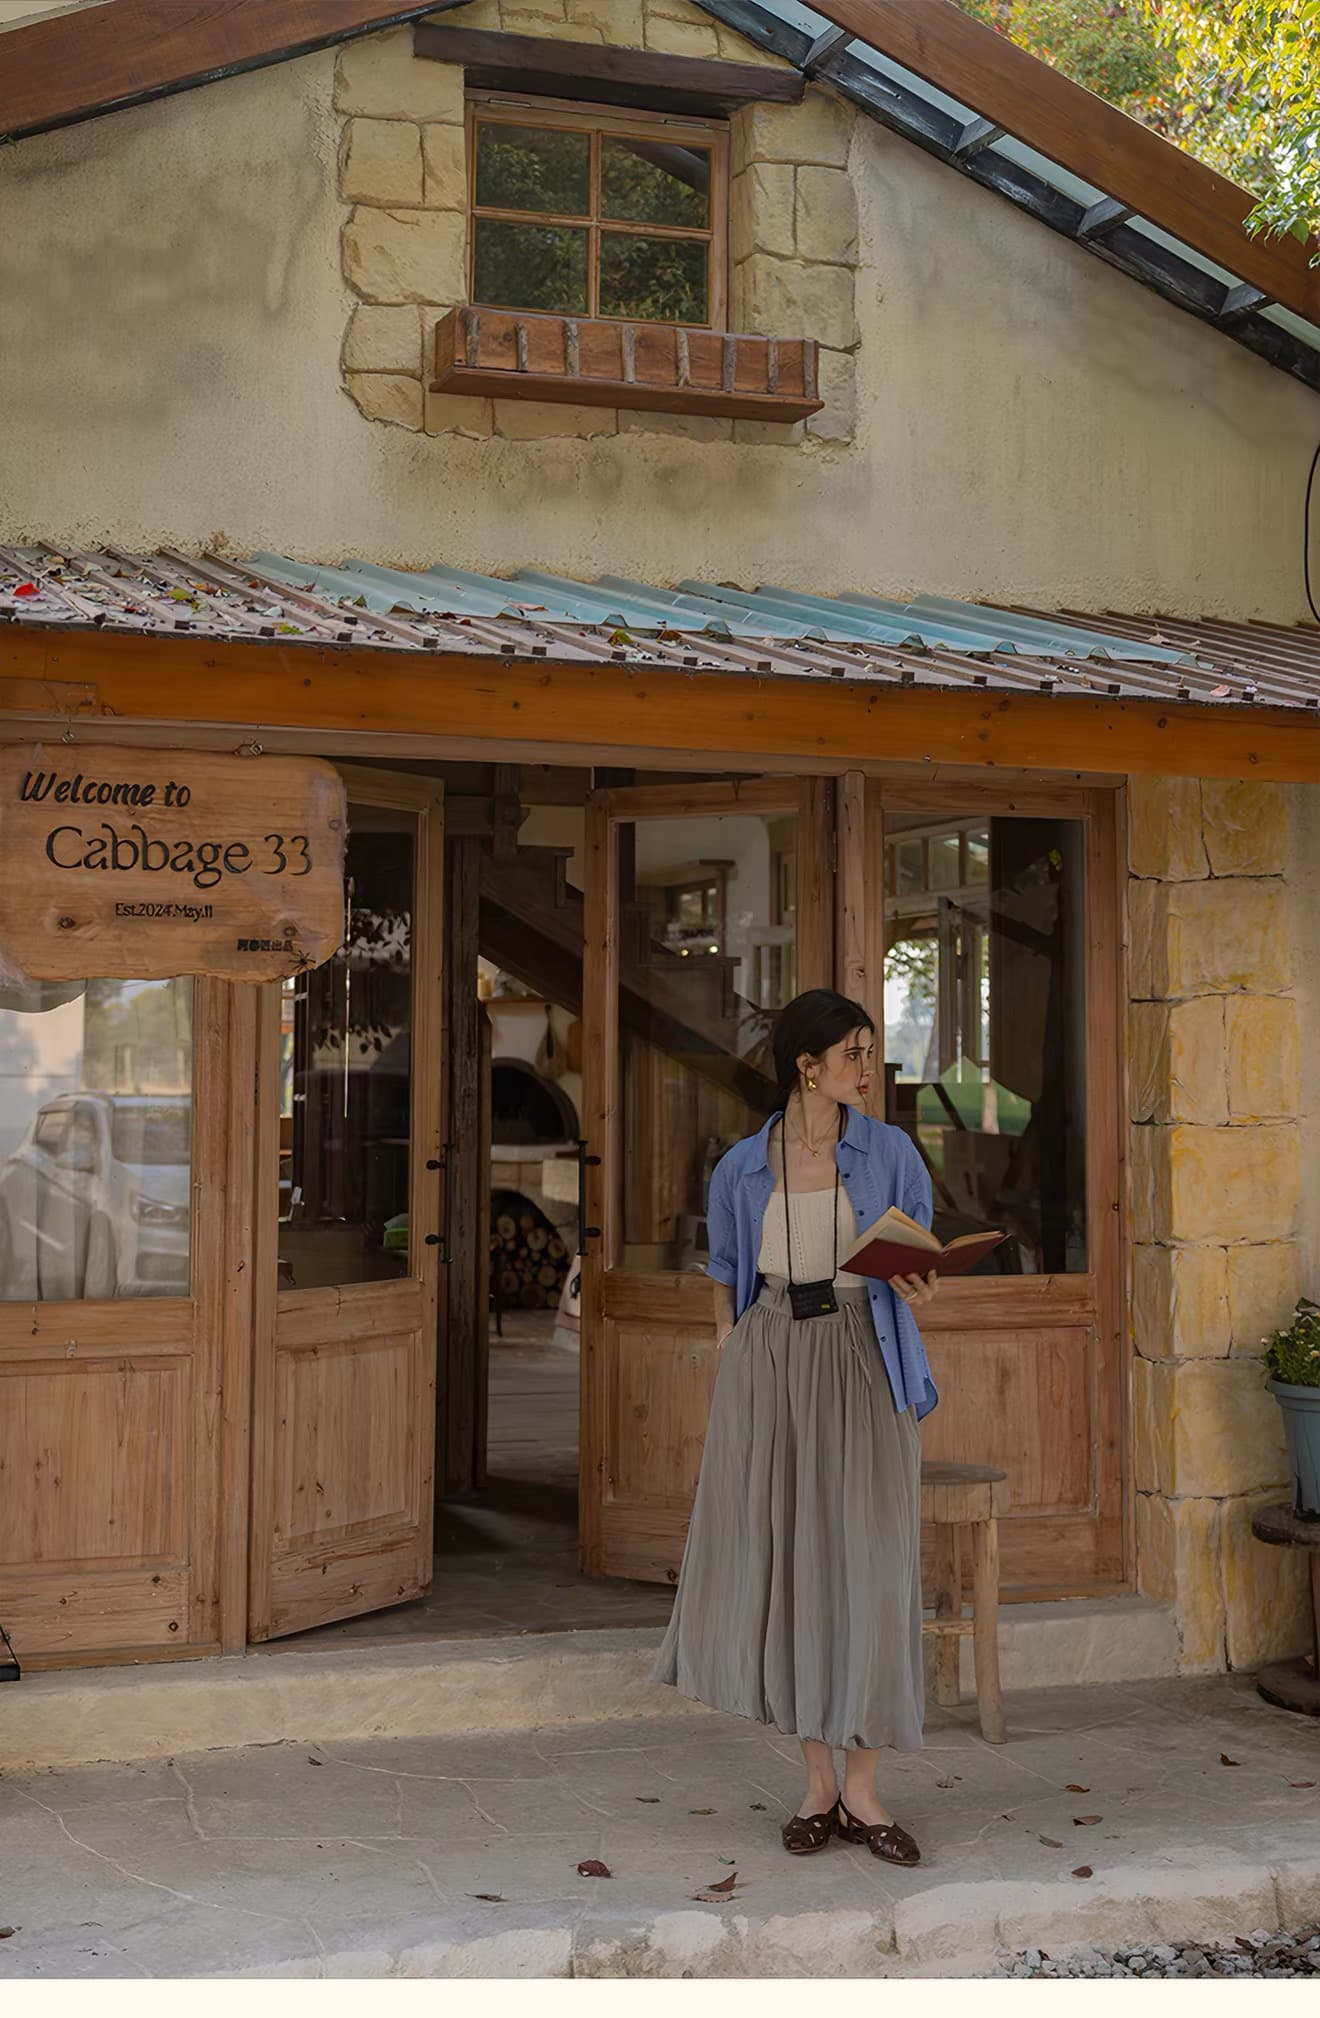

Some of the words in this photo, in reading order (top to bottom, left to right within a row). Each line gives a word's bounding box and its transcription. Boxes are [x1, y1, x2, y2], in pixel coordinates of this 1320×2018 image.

[20, 771, 156, 808] Welcome
[164, 780, 191, 808] to
[45, 823, 253, 889] Cabbage
[263, 834, 313, 876] 33
